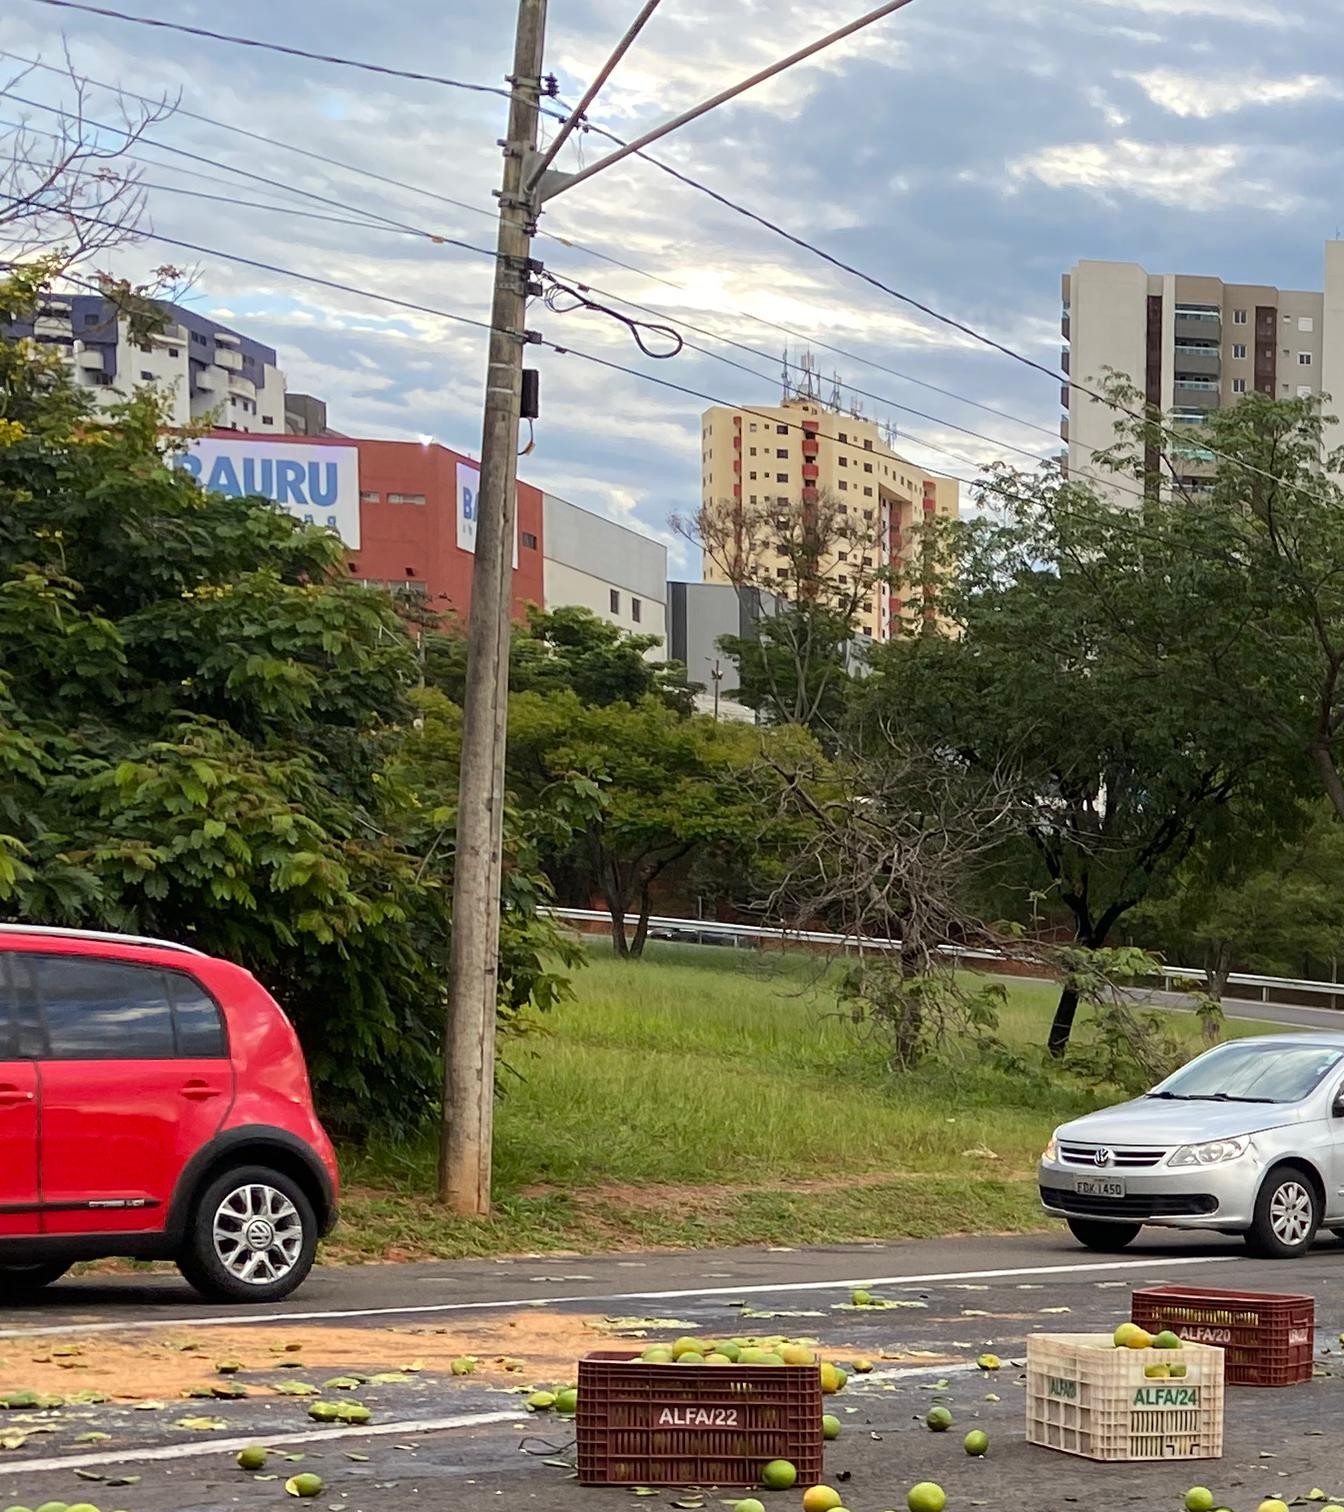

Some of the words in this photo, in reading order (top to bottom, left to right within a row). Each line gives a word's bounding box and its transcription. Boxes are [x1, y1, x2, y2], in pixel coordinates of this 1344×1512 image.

[1179, 1327, 1231, 1343] ALFA/20
[1133, 1389, 1197, 1406] ALFA/24
[659, 1408, 738, 1426] ALFA/22
